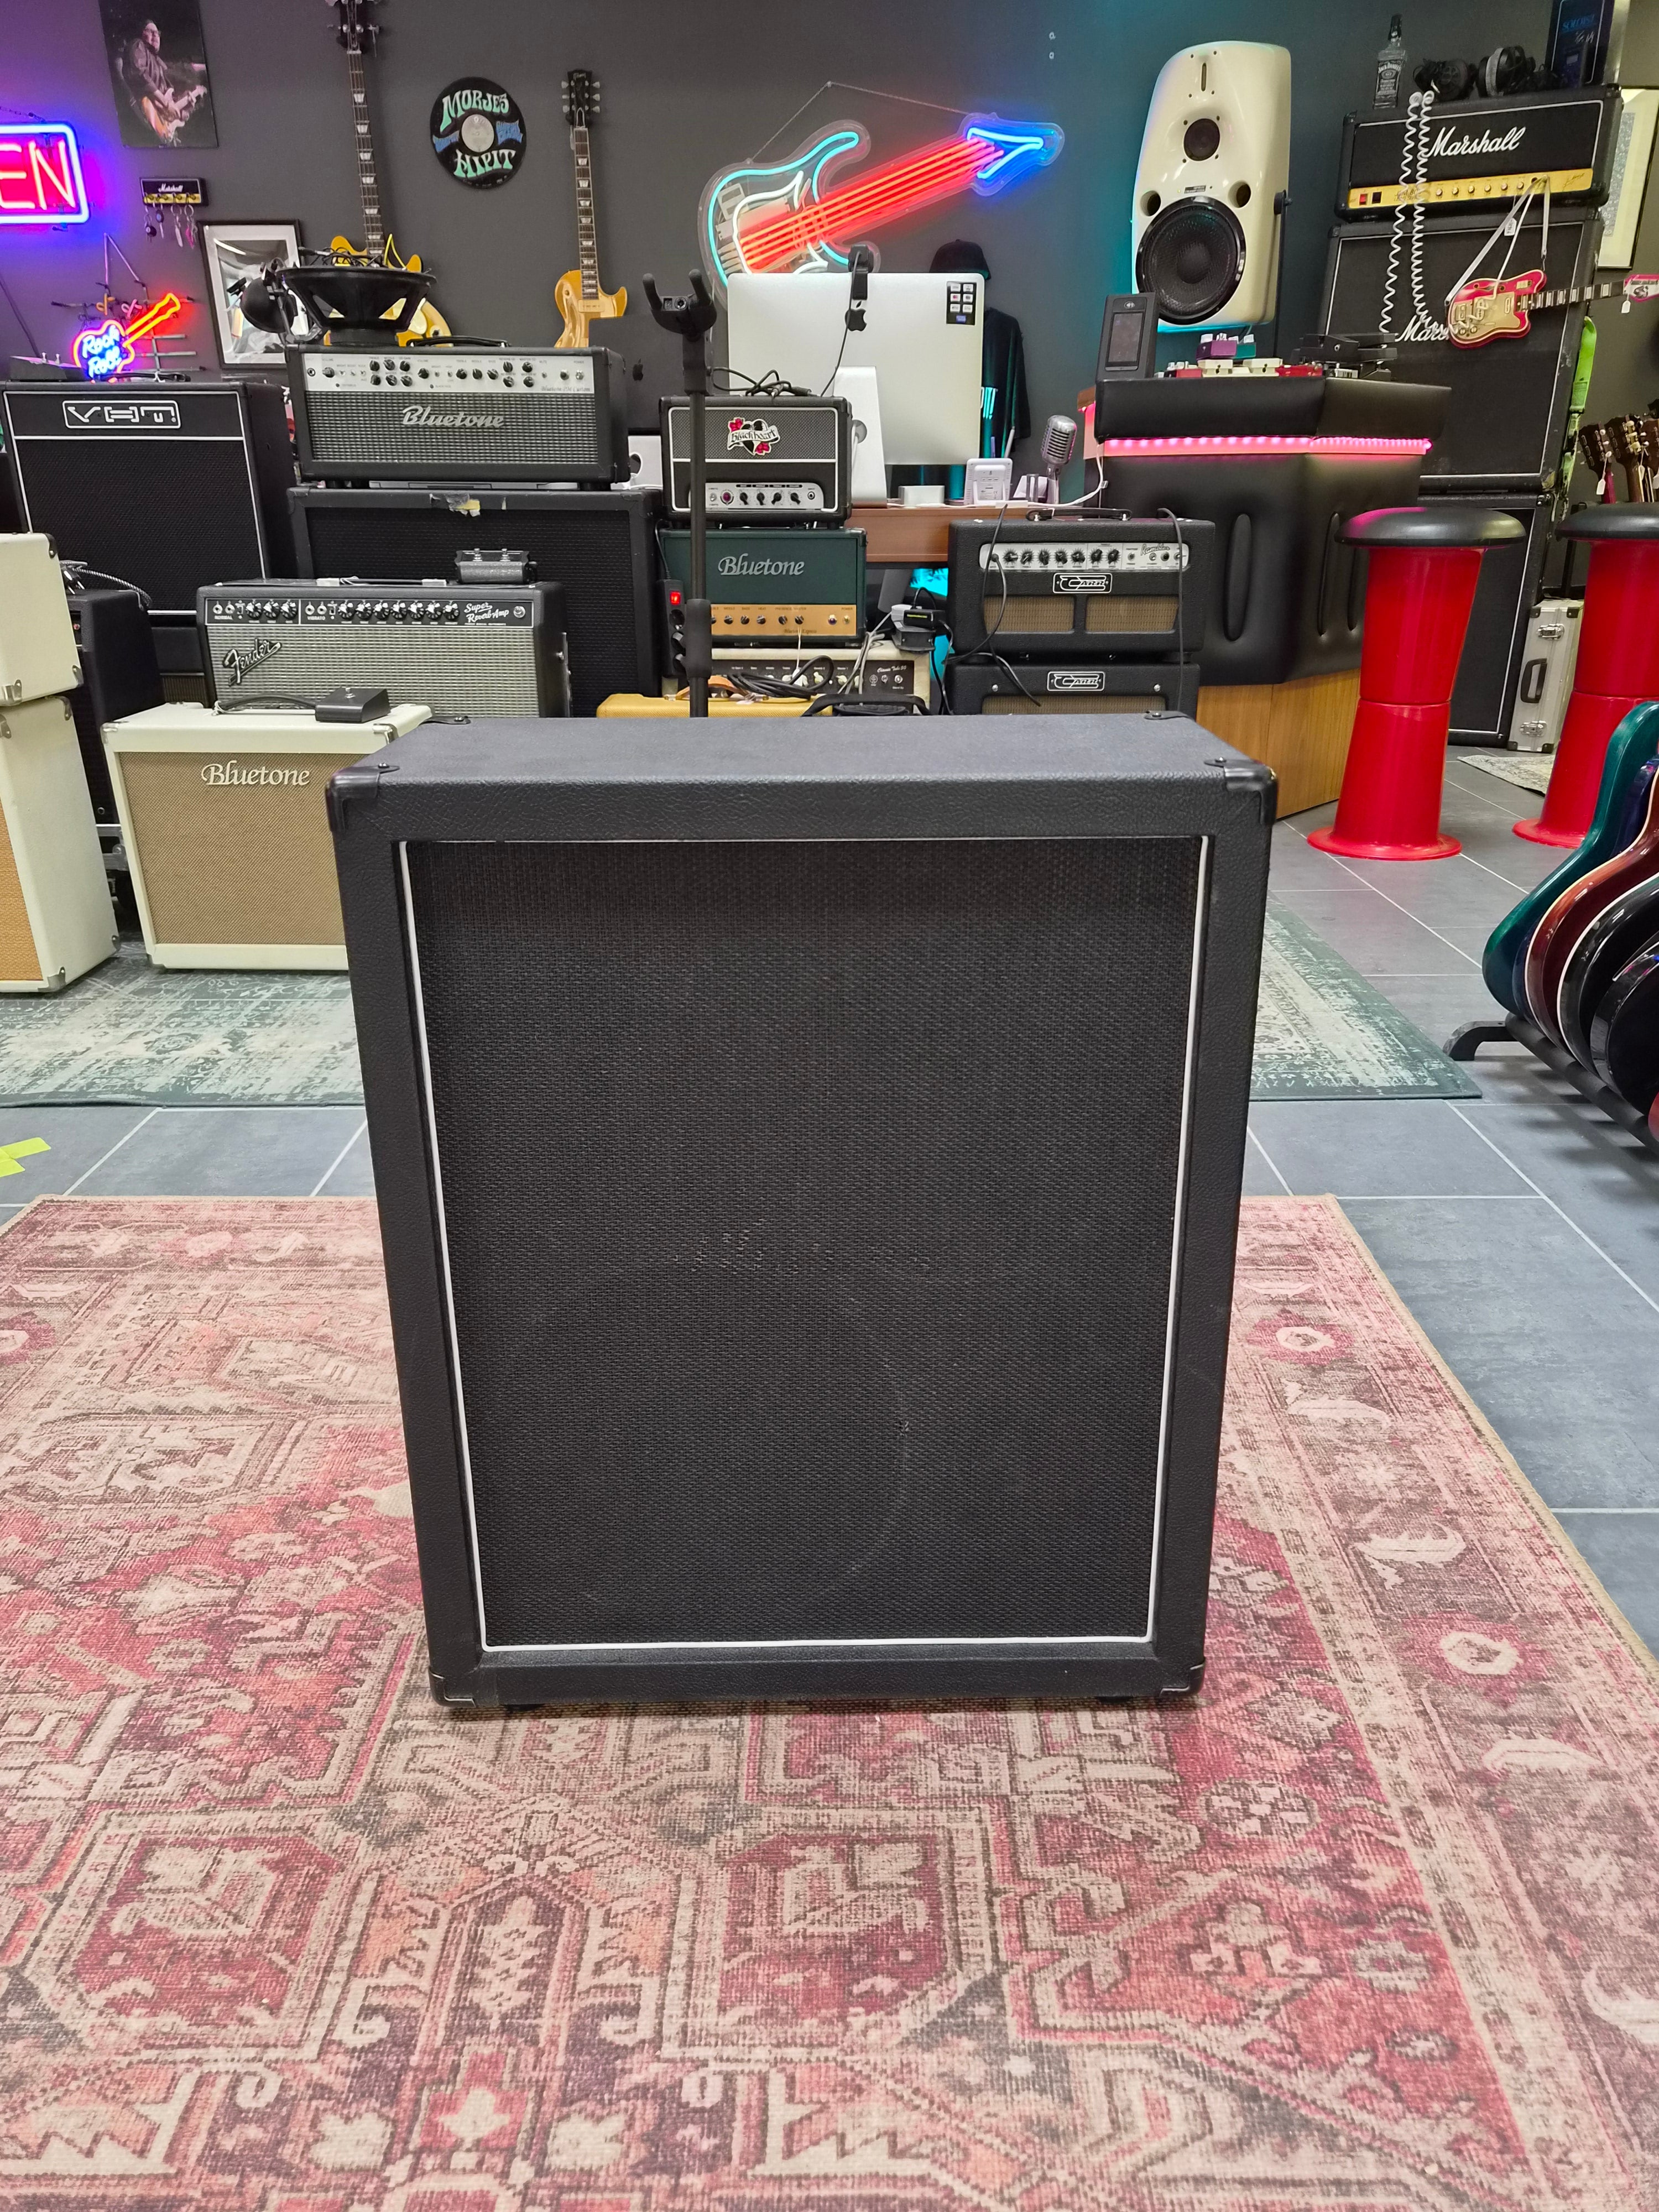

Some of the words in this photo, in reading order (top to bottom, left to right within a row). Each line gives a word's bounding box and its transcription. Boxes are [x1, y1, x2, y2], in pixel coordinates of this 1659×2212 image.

[440, 90, 509, 133] MORJES
[1421, 126, 1526, 158] Marshall
[82, 324, 120, 359] Rock
[88, 346, 122, 379] Roll
[67, 406, 179, 423] VHT
[402, 405, 504, 427] Bluetone
[732, 429, 776, 442] Blackheart
[718, 553, 805, 575] Bluetone
[464, 602, 493, 613] Super
[225, 639, 281, 684] Fender
[201, 760, 310, 785] Bluetone
